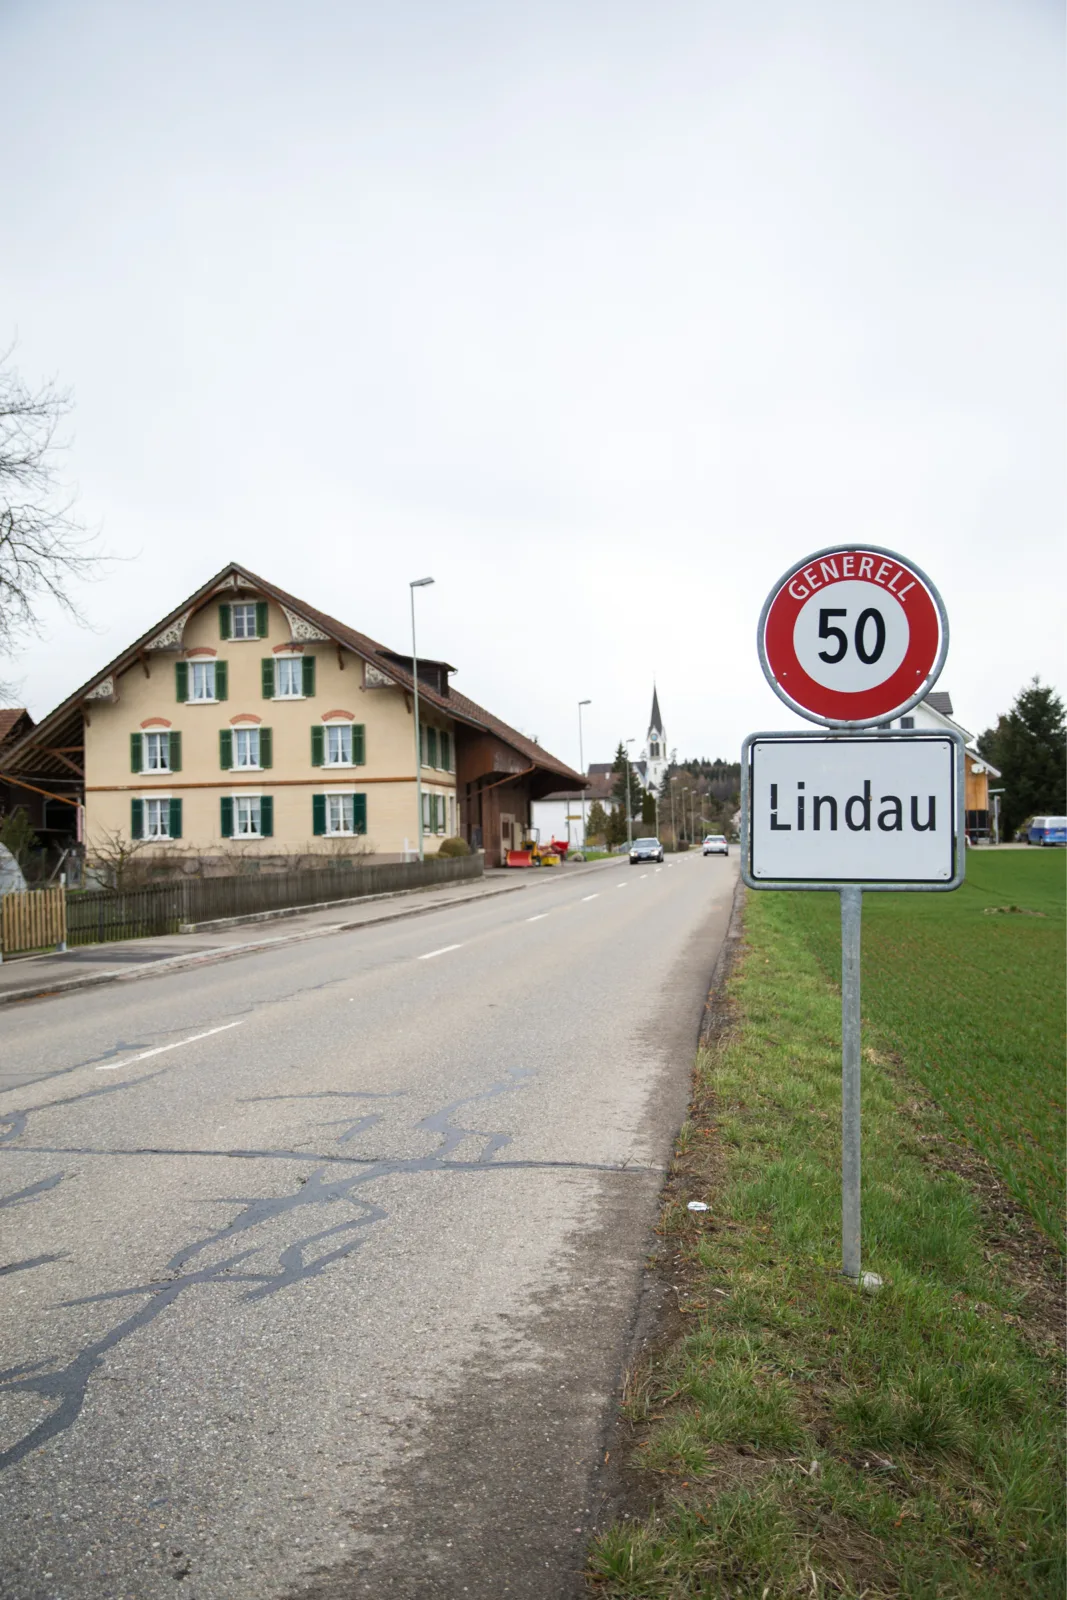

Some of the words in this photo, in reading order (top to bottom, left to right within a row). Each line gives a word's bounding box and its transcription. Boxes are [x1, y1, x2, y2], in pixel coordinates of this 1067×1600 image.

[788, 556, 916, 602] GENERELL
[818, 608, 886, 665] 50
[770, 780, 936, 832] Lindau
